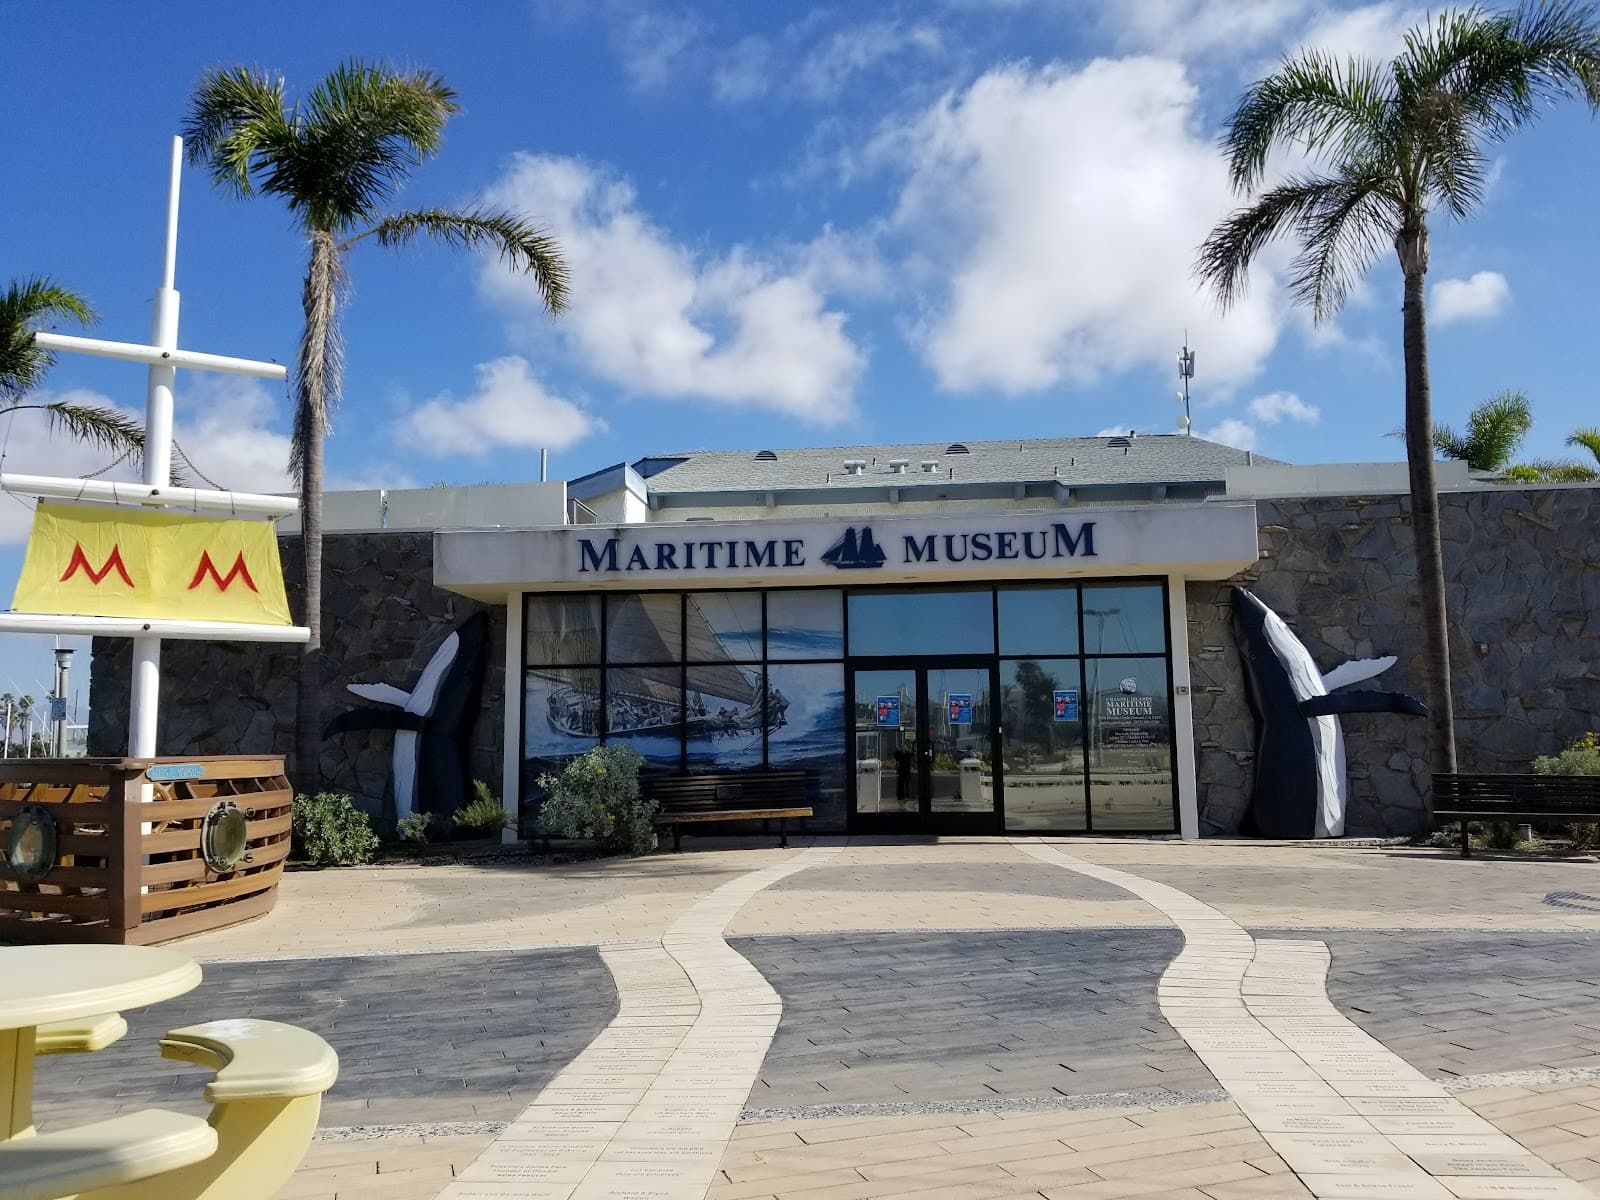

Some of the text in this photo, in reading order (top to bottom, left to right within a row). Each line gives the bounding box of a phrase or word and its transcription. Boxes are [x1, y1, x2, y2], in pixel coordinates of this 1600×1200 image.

[578, 522, 1098, 572] MARITIME MUSEUM
[1106, 707, 1152, 715] MUSEUM
